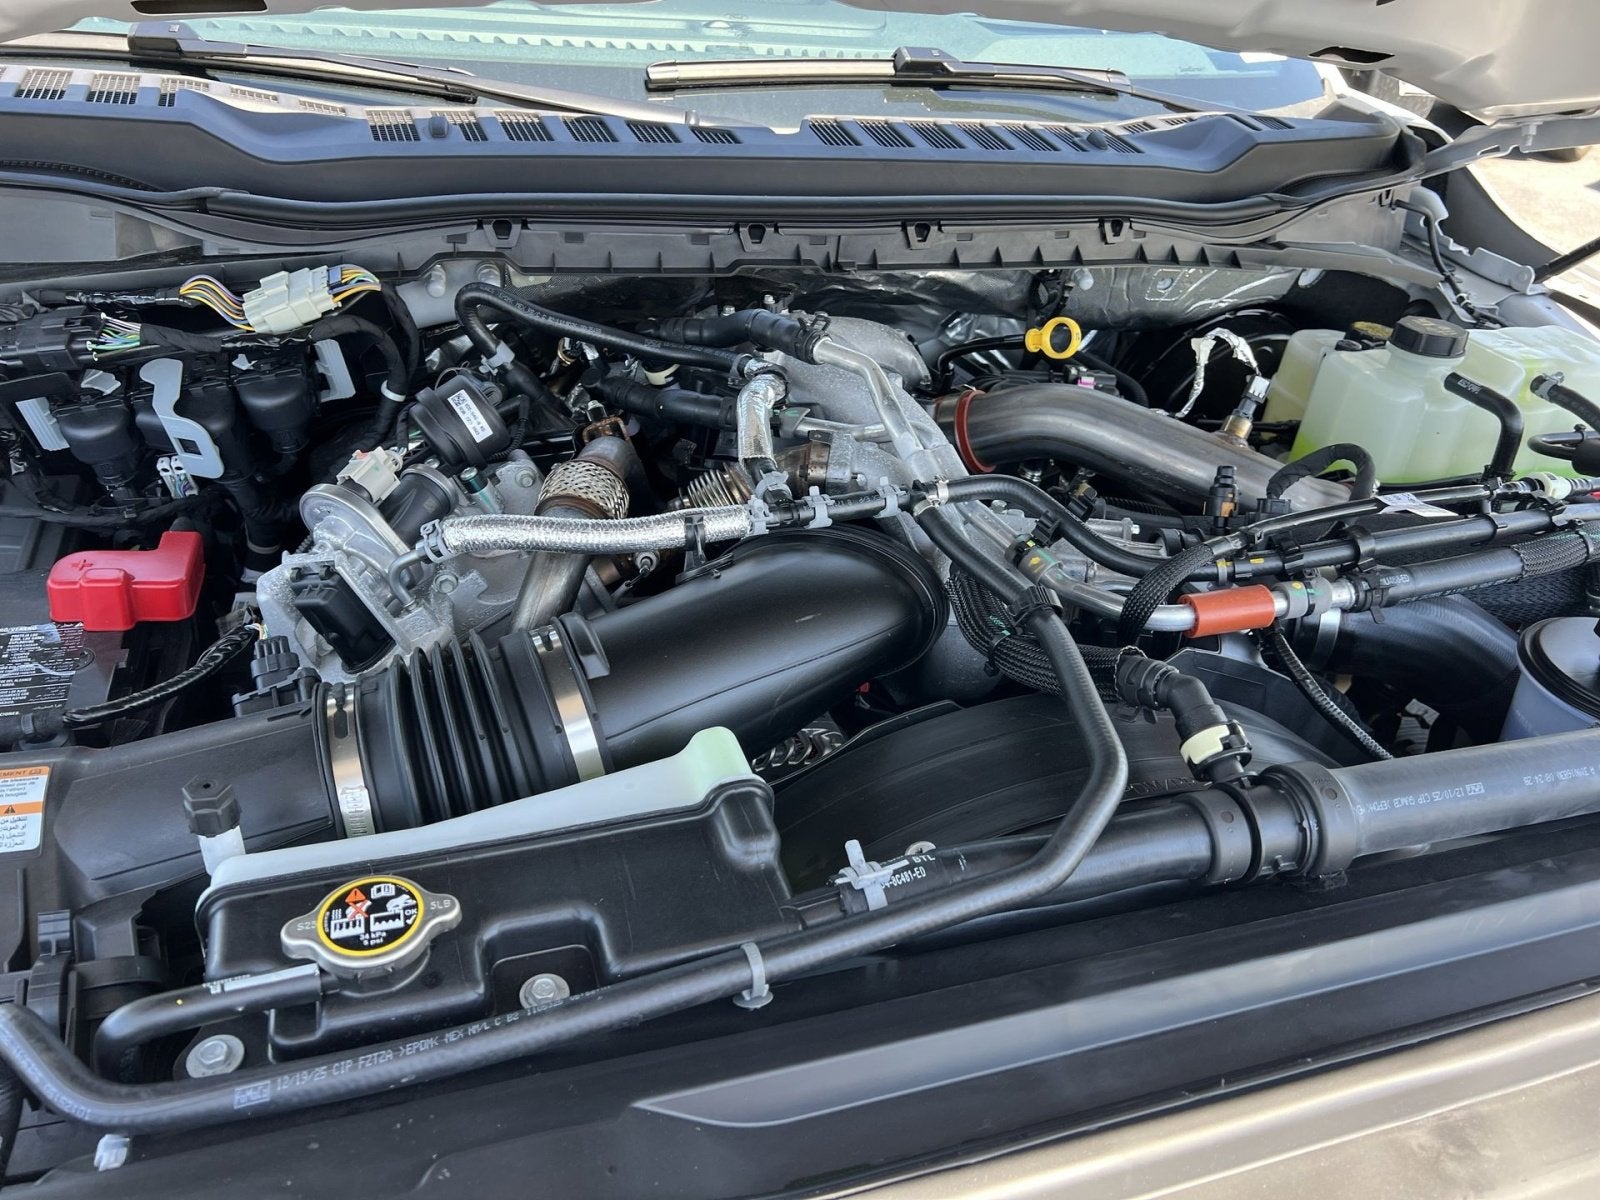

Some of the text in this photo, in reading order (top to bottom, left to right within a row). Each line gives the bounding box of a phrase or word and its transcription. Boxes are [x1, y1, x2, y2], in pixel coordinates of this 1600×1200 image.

[405, 907, 418, 917] OK
[371, 931, 387, 939] kPa
[370, 937, 384, 946] psi
[276, 1065, 328, 1090] 12/19/25
[332, 1059, 353, 1077] CIP
